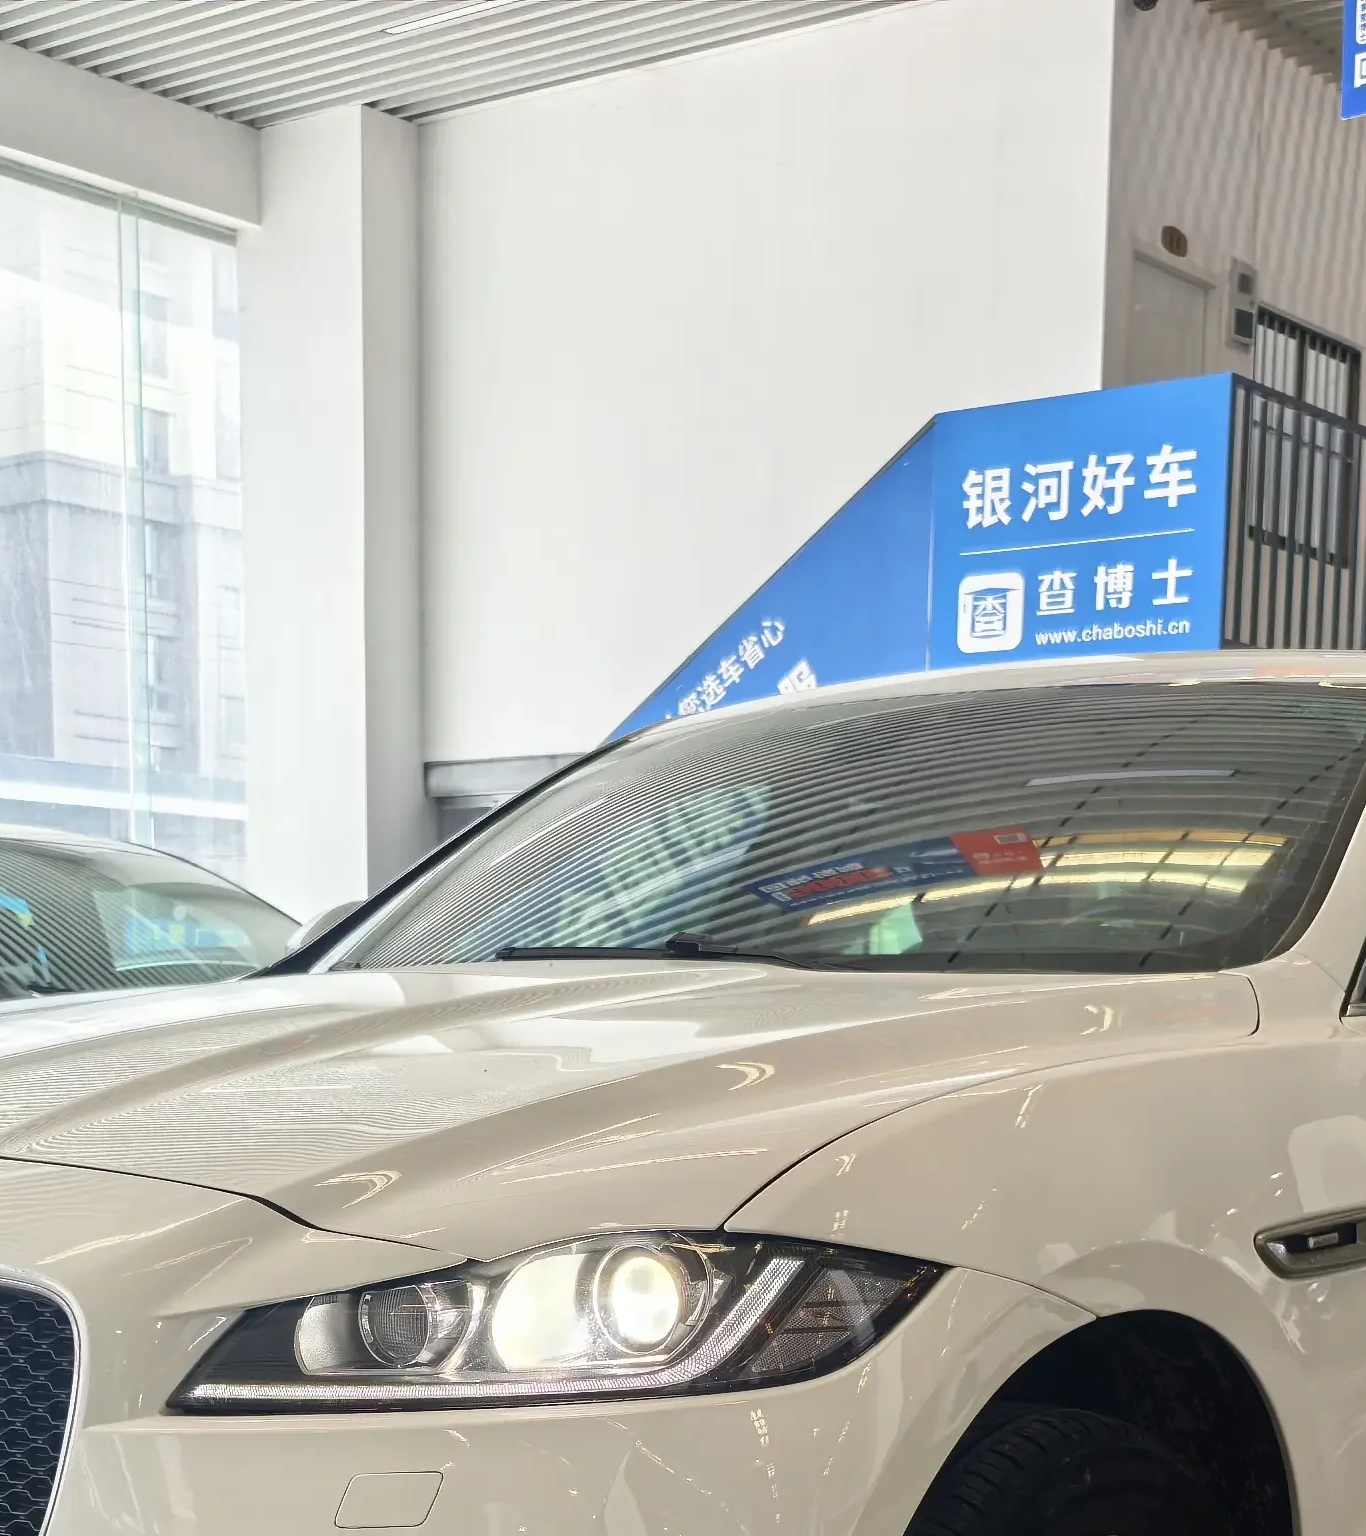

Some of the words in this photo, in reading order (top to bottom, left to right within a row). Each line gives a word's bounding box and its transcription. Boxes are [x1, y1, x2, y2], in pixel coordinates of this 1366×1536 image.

[961, 444, 1198, 529] 银河好车
[1036, 557, 1194, 616] 查博士
[1035, 619, 1191, 645] www.chaboshi.cn
[664, 619, 785, 720] 您选车省心
